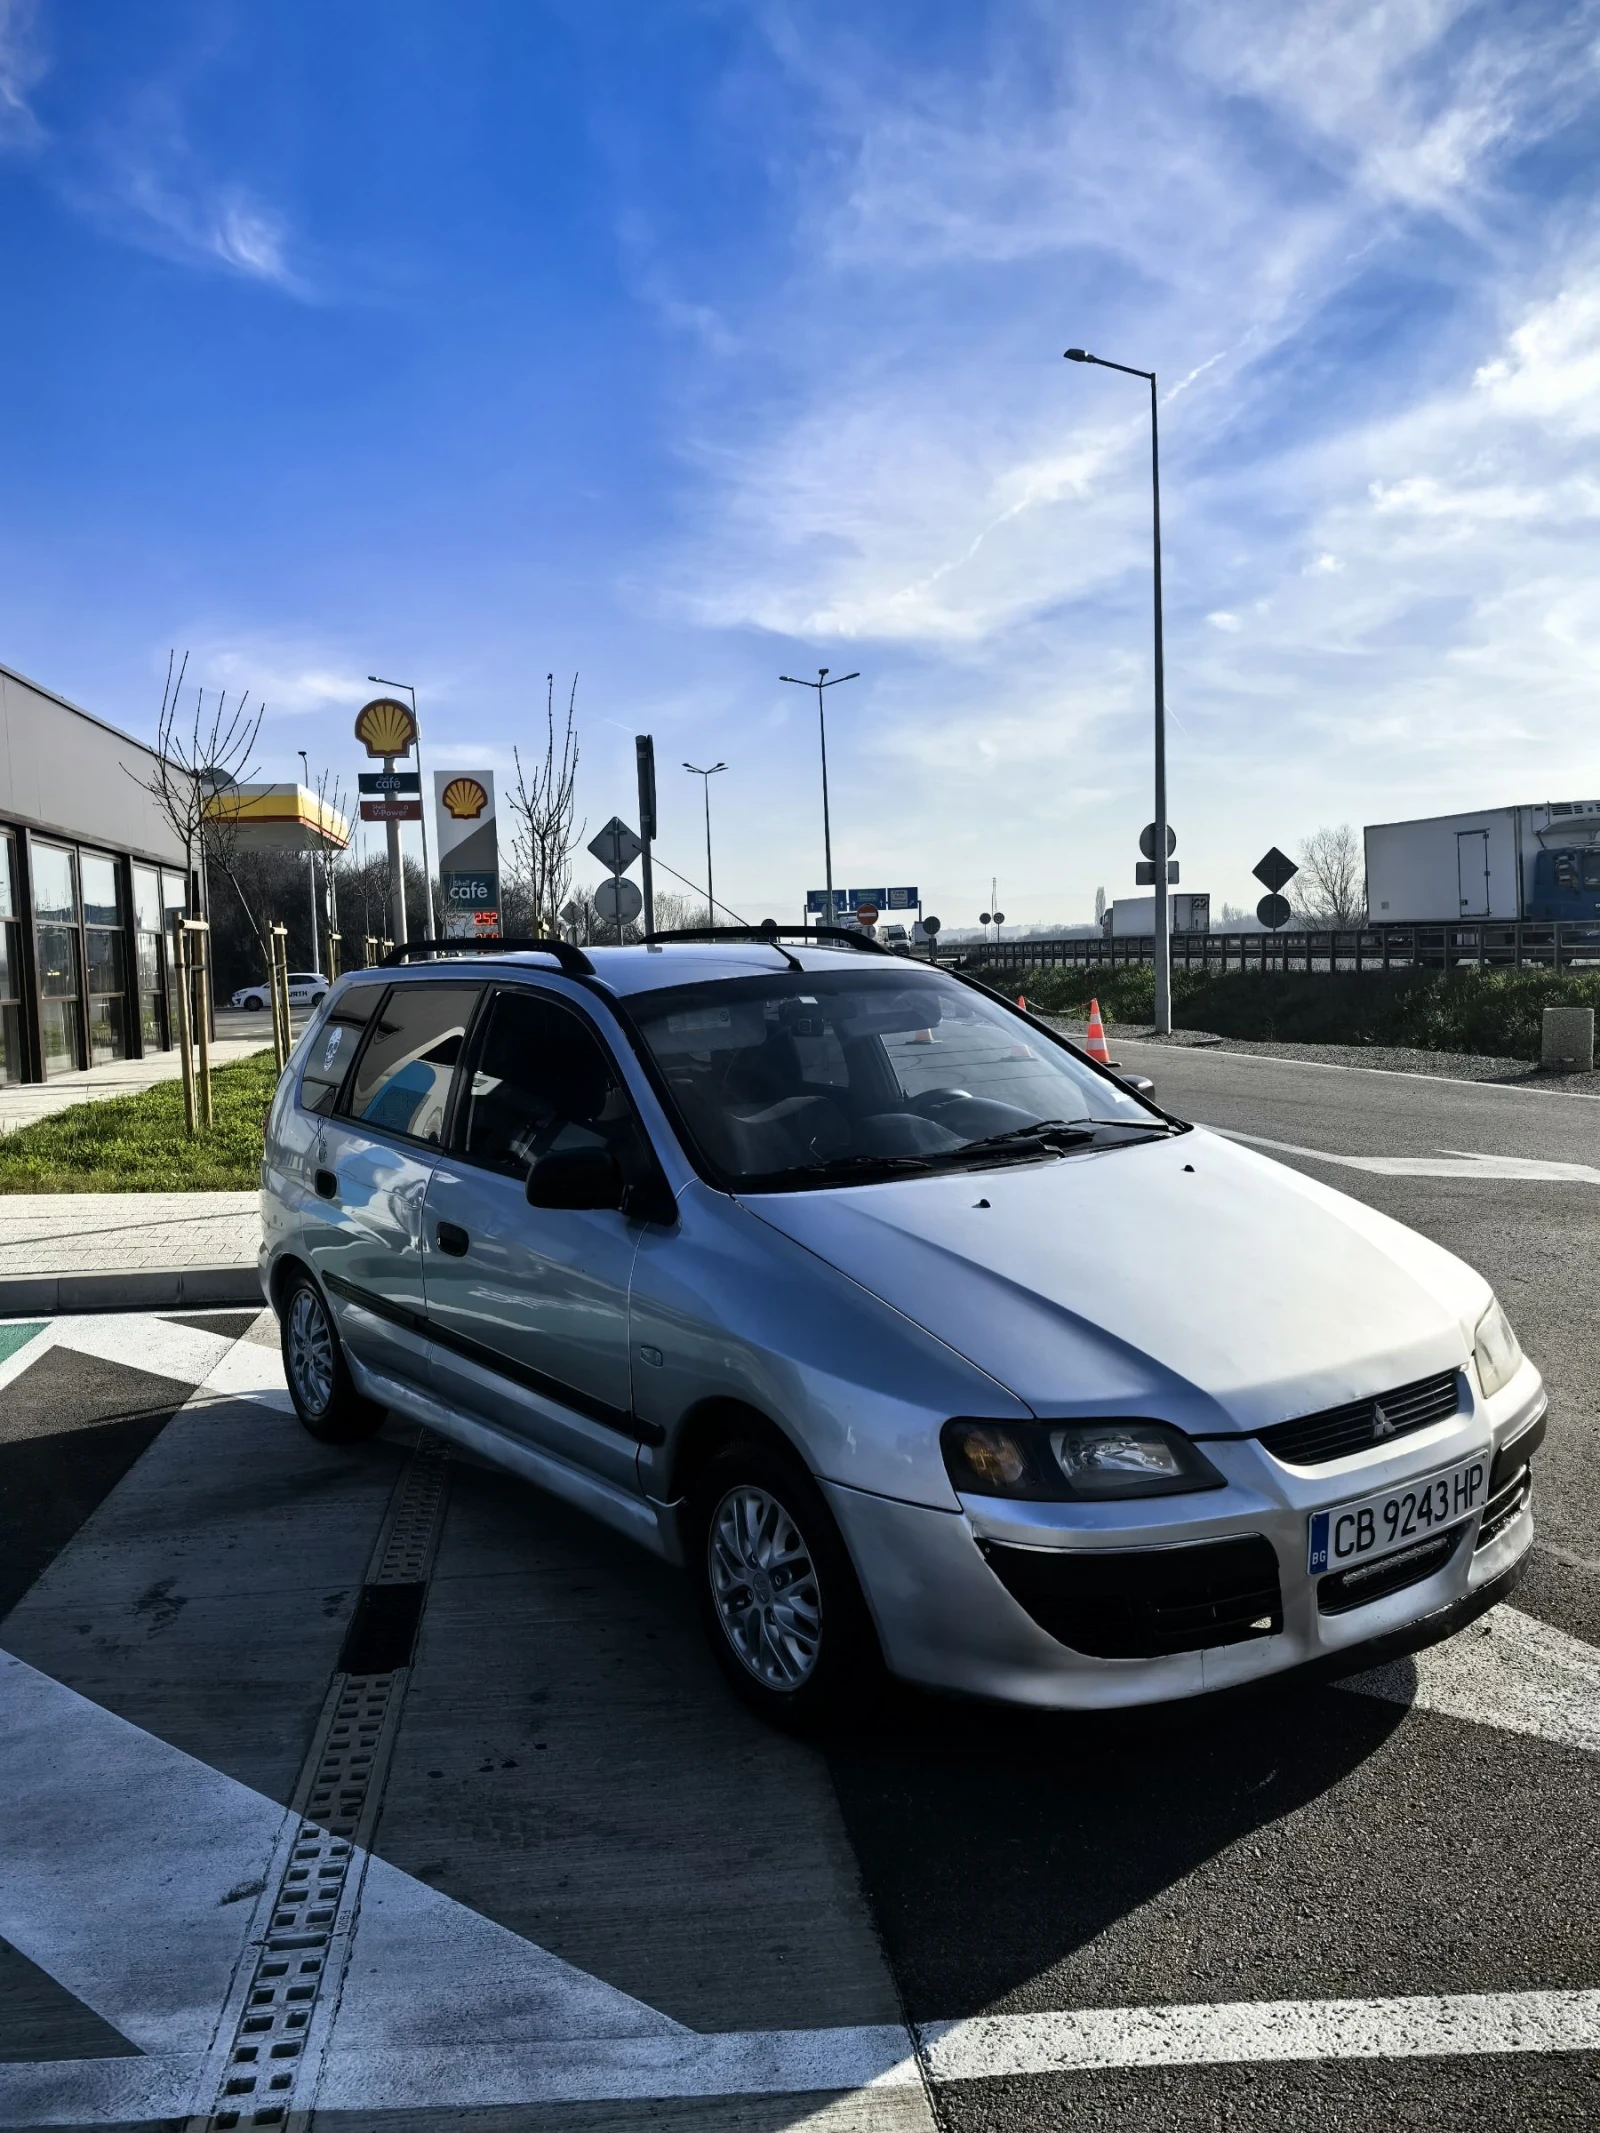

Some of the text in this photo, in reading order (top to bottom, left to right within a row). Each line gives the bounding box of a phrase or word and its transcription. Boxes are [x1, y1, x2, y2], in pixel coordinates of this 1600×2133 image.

[375, 776, 401, 789] café
[372, 809, 408, 817] V-Power
[450, 881, 488, 899] café
[1334, 1463, 1484, 1558] CB 9243 HP
[1311, 1550, 1326, 1565] BG
